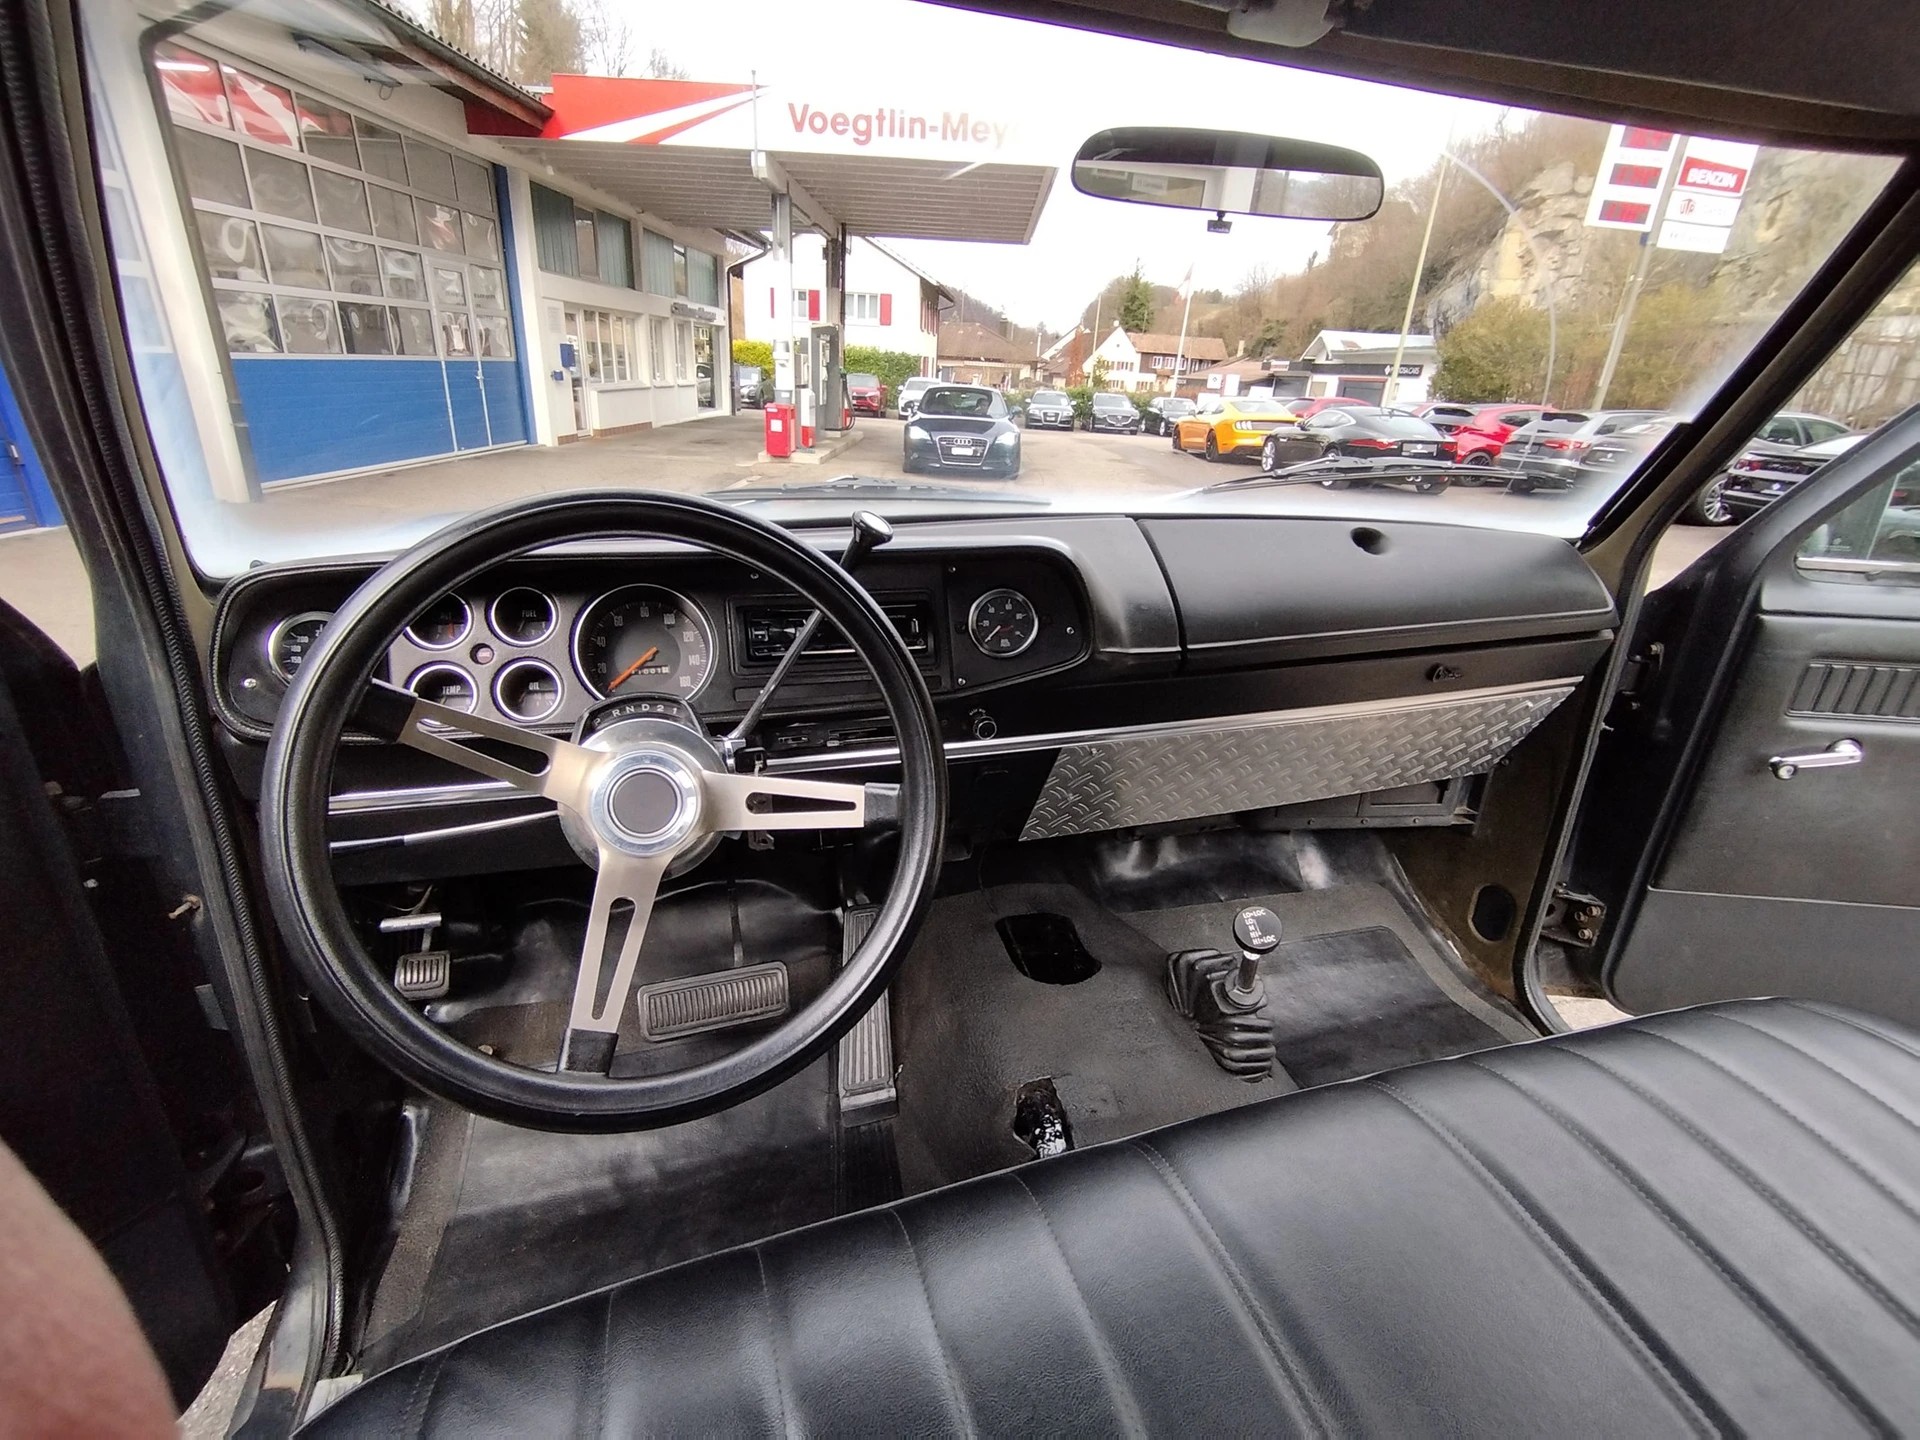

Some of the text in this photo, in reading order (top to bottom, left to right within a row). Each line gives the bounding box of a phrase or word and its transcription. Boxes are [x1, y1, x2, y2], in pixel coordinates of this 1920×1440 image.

[788, 103, 1008, 149] Voegtlin-Mey
[522, 610, 537, 618] FUEL
[442, 685, 461, 695] TEMP
[529, 682, 540, 691] OIL
[612, 709, 621, 718] R
[625, 705, 635, 714] N
[641, 703, 650, 711] D
[656, 704, 665, 712] 2
[672, 707, 678, 715] 1
